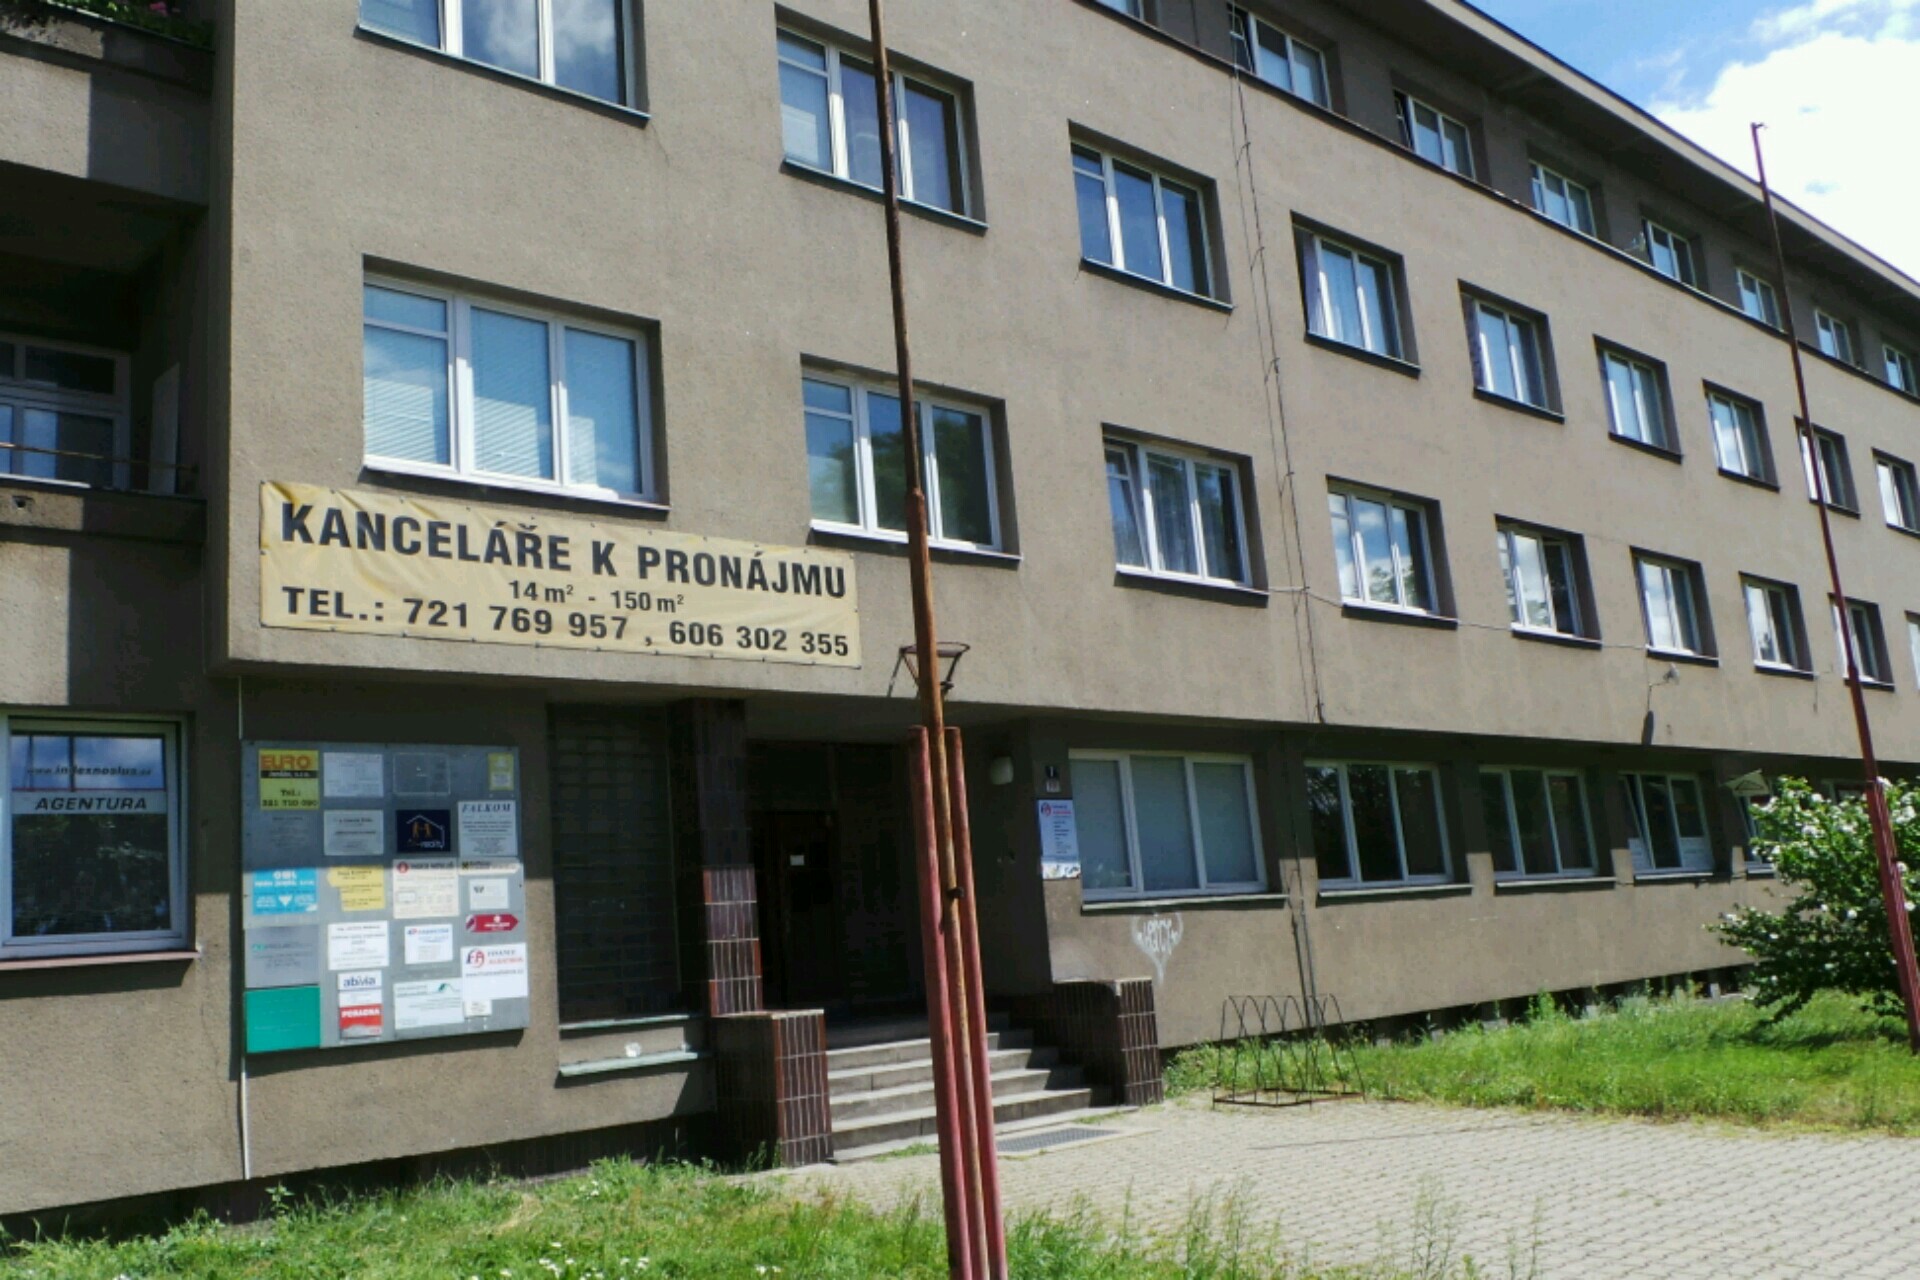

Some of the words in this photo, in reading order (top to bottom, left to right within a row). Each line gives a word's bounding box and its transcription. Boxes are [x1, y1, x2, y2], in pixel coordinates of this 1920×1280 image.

[281, 502, 572, 572] KANCELÁŘE
[591, 540, 617, 577] K
[637, 545, 846, 598] PRONÁJMU
[509, 580, 538, 601] 14
[610, 589, 651, 612] 150
[282, 585, 385, 623] TEL.:
[402, 597, 468, 629] 721
[488, 605, 552, 635] 769
[568, 612, 628, 640] 957
[669, 620, 724, 647] 606
[736, 625, 788, 651] 302
[800, 631, 849, 657] 355
[261, 754, 312, 770] EURO
[35, 797, 148, 811] AGENTURA
[462, 802, 511, 813] FALKOM
